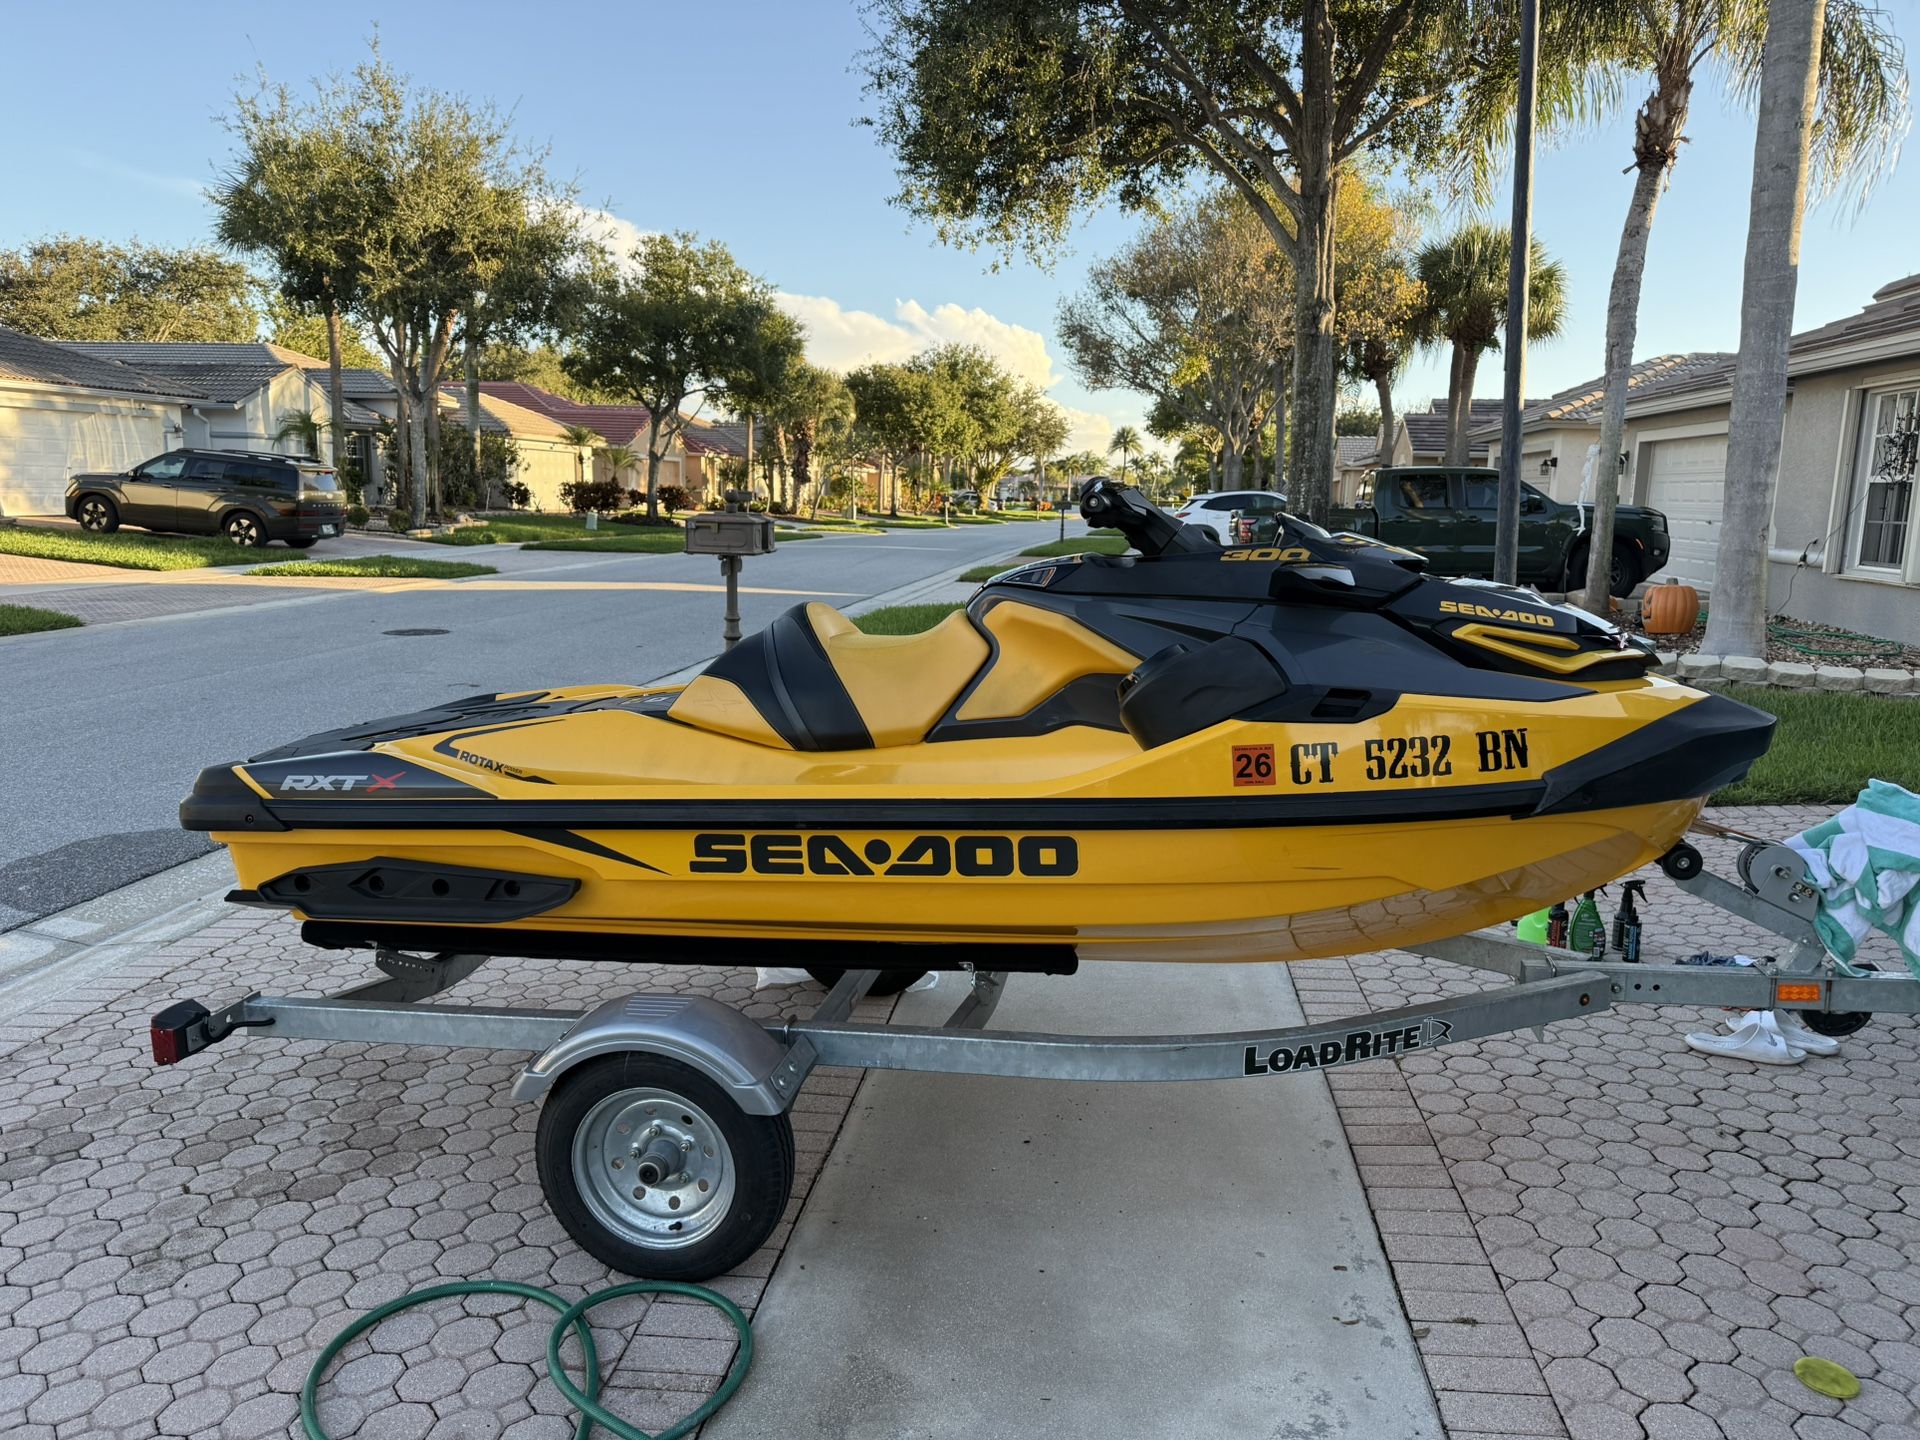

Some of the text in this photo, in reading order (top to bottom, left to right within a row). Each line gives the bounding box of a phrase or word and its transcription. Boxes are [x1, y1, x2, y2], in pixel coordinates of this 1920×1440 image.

[1220, 548, 1311, 562] 300
[460, 750, 504, 773] ROTAX
[1236, 753, 1272, 778] 26
[1290, 728, 1528, 785] CT 5232 BN
